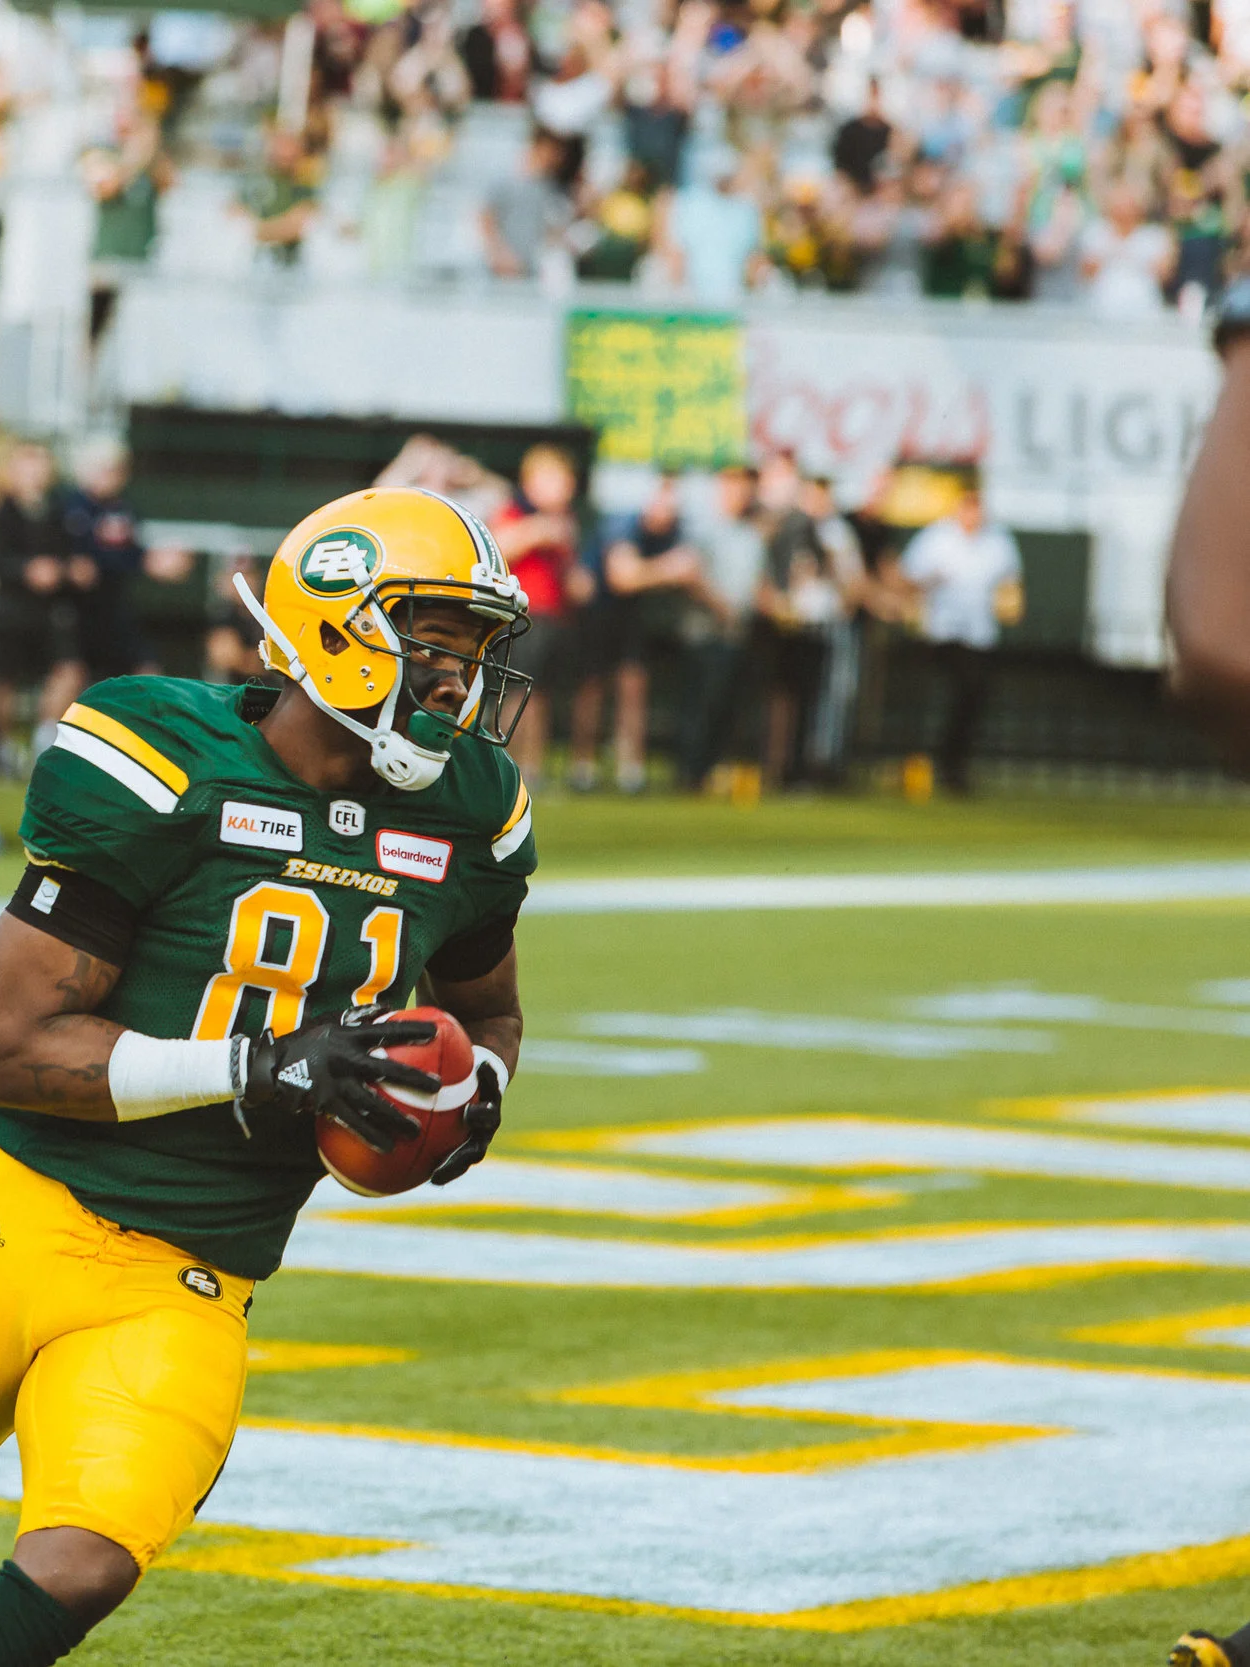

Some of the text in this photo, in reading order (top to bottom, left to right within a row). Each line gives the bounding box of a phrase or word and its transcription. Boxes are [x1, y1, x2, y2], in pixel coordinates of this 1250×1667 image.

[335, 810, 359, 828] CFL
[281, 853, 399, 897] ESKIMOS
[190, 881, 405, 1041] 81
